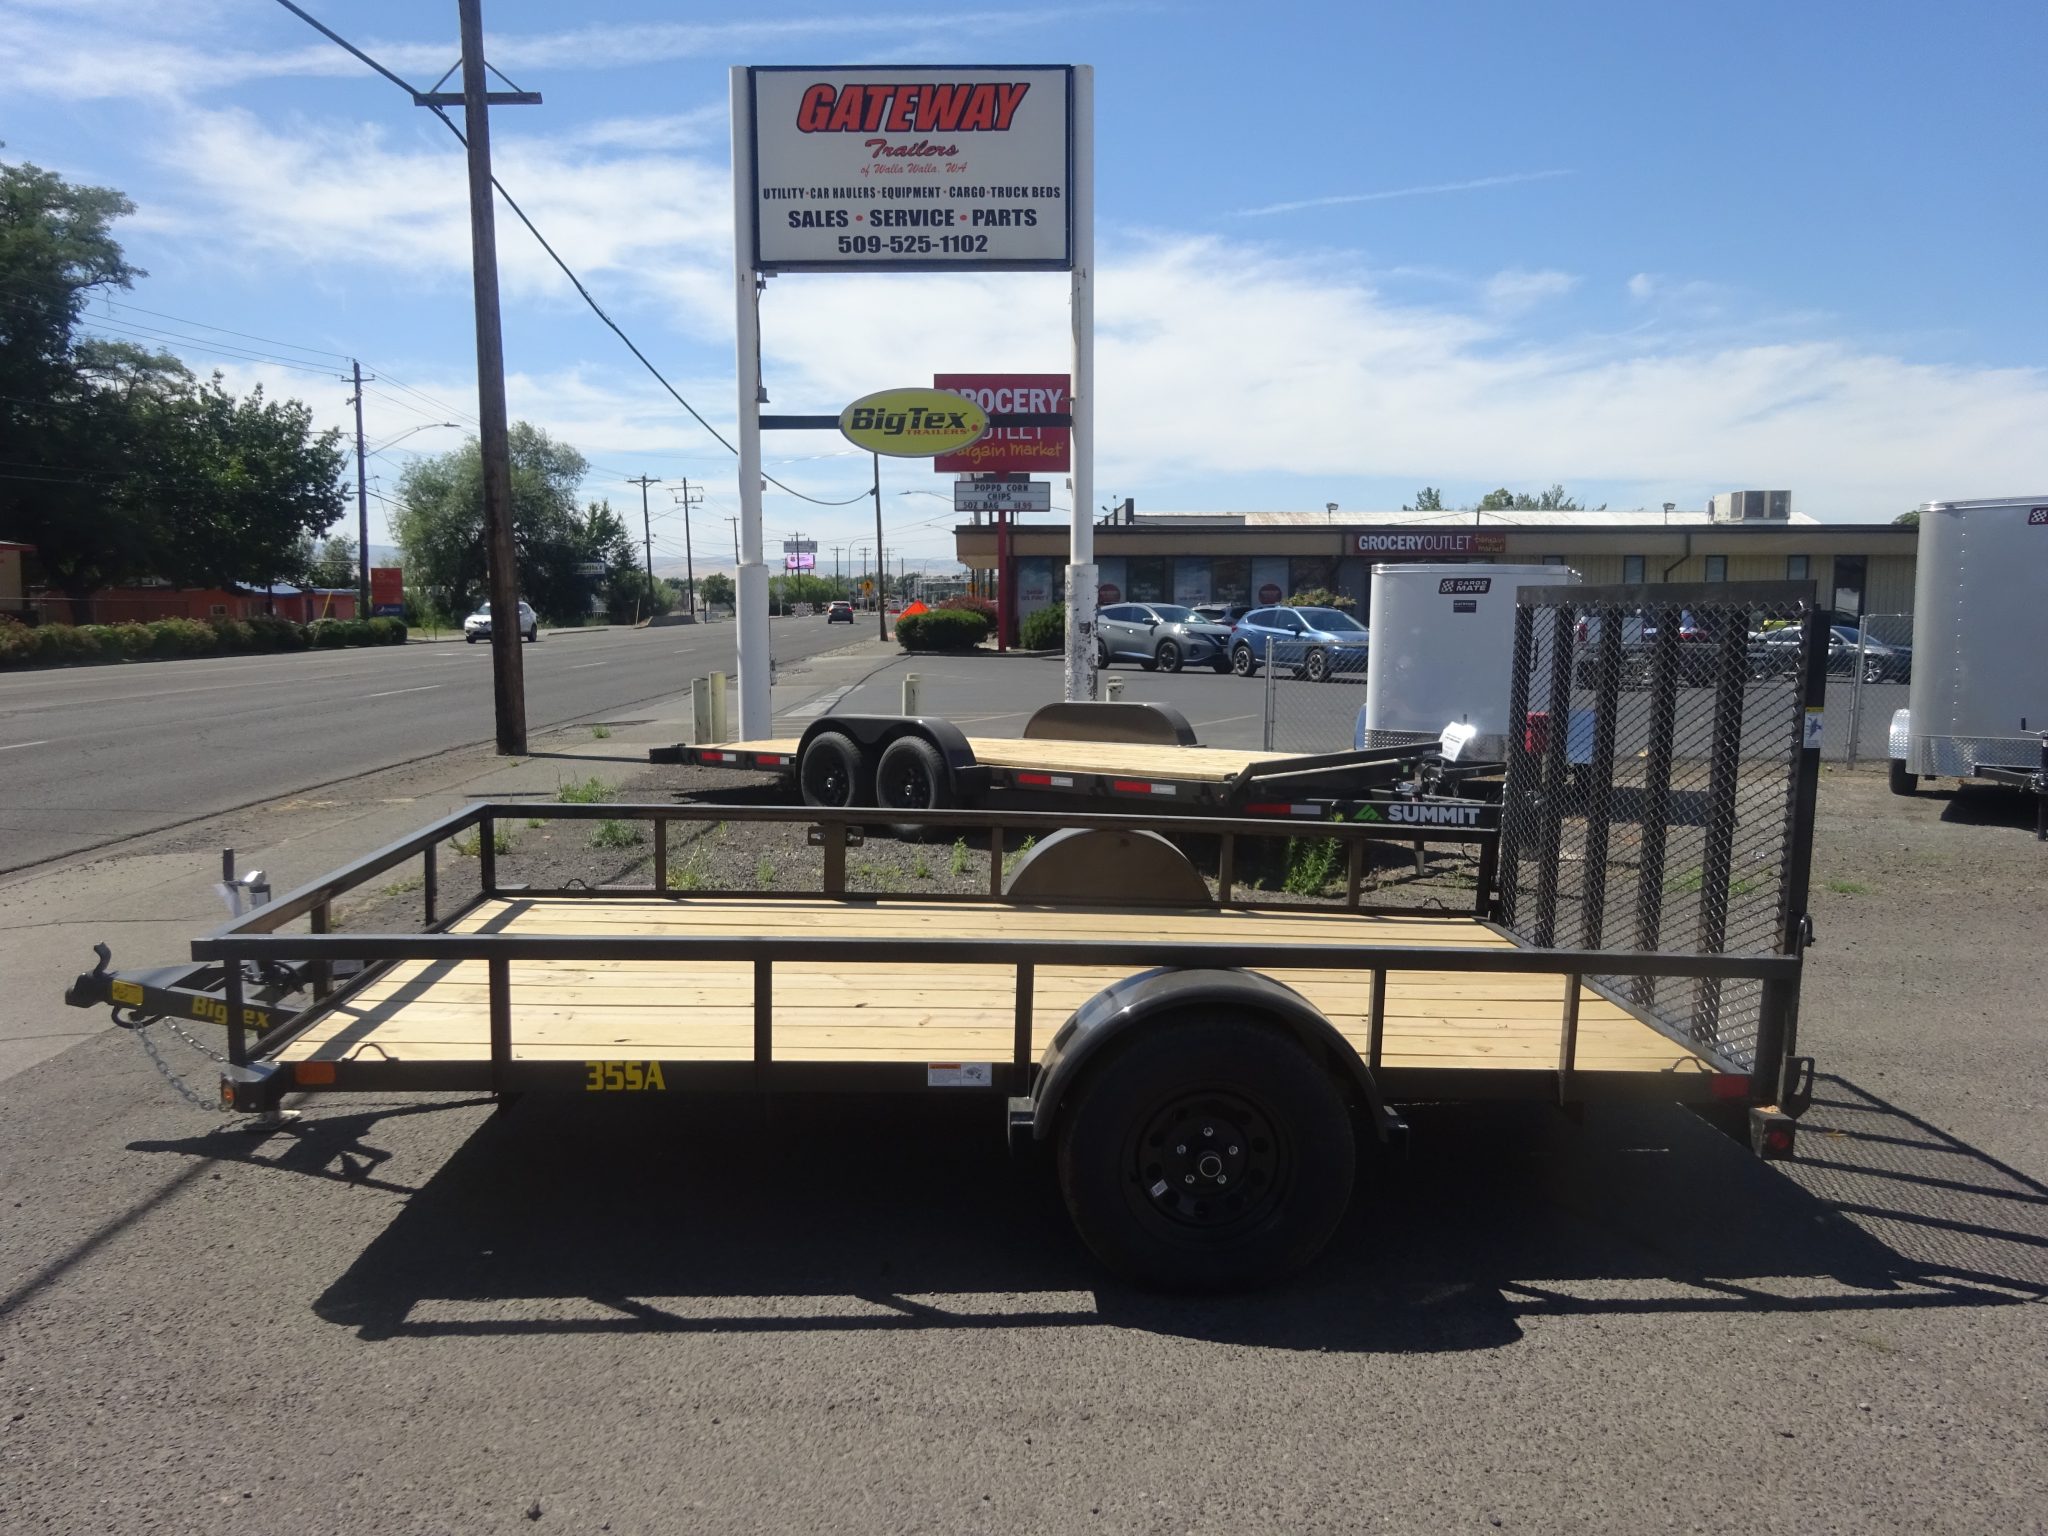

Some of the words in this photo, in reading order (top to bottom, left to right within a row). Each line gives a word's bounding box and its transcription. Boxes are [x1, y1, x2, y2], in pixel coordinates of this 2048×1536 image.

[796, 82, 1030, 133] GATEWAY
[865, 138, 960, 159] Trailers
[860, 163, 870, 177] of
[874, 163, 904, 174] Walla
[945, 162, 968, 173] WA
[763, 187, 804, 199] UTILITY
[810, 187, 830, 199] CAR
[832, 186, 876, 199] HAULERS
[881, 186, 941, 199] EQUIPMENT
[949, 186, 986, 198] CARGO
[990, 186, 1029, 198] TRUCK
[1032, 186, 1061, 198] BEDS
[788, 209, 849, 228] SALES
[870, 209, 955, 227] SERVICE
[972, 209, 1037, 227] PARTS
[838, 235, 988, 253] 509-525-1102
[851, 407, 968, 435] BigTex
[944, 442, 1006, 464] argain
[1010, 441, 1062, 457] market
[974, 483, 1002, 492] POPPD
[1006, 483, 1029, 492] CORN
[987, 493, 1011, 501] CHIPS
[983, 501, 999, 509] BAG
[1387, 806, 1480, 825] SUMMIT
[192, 995, 270, 1029] Bigex
[586, 1060, 666, 1090] 35SA
